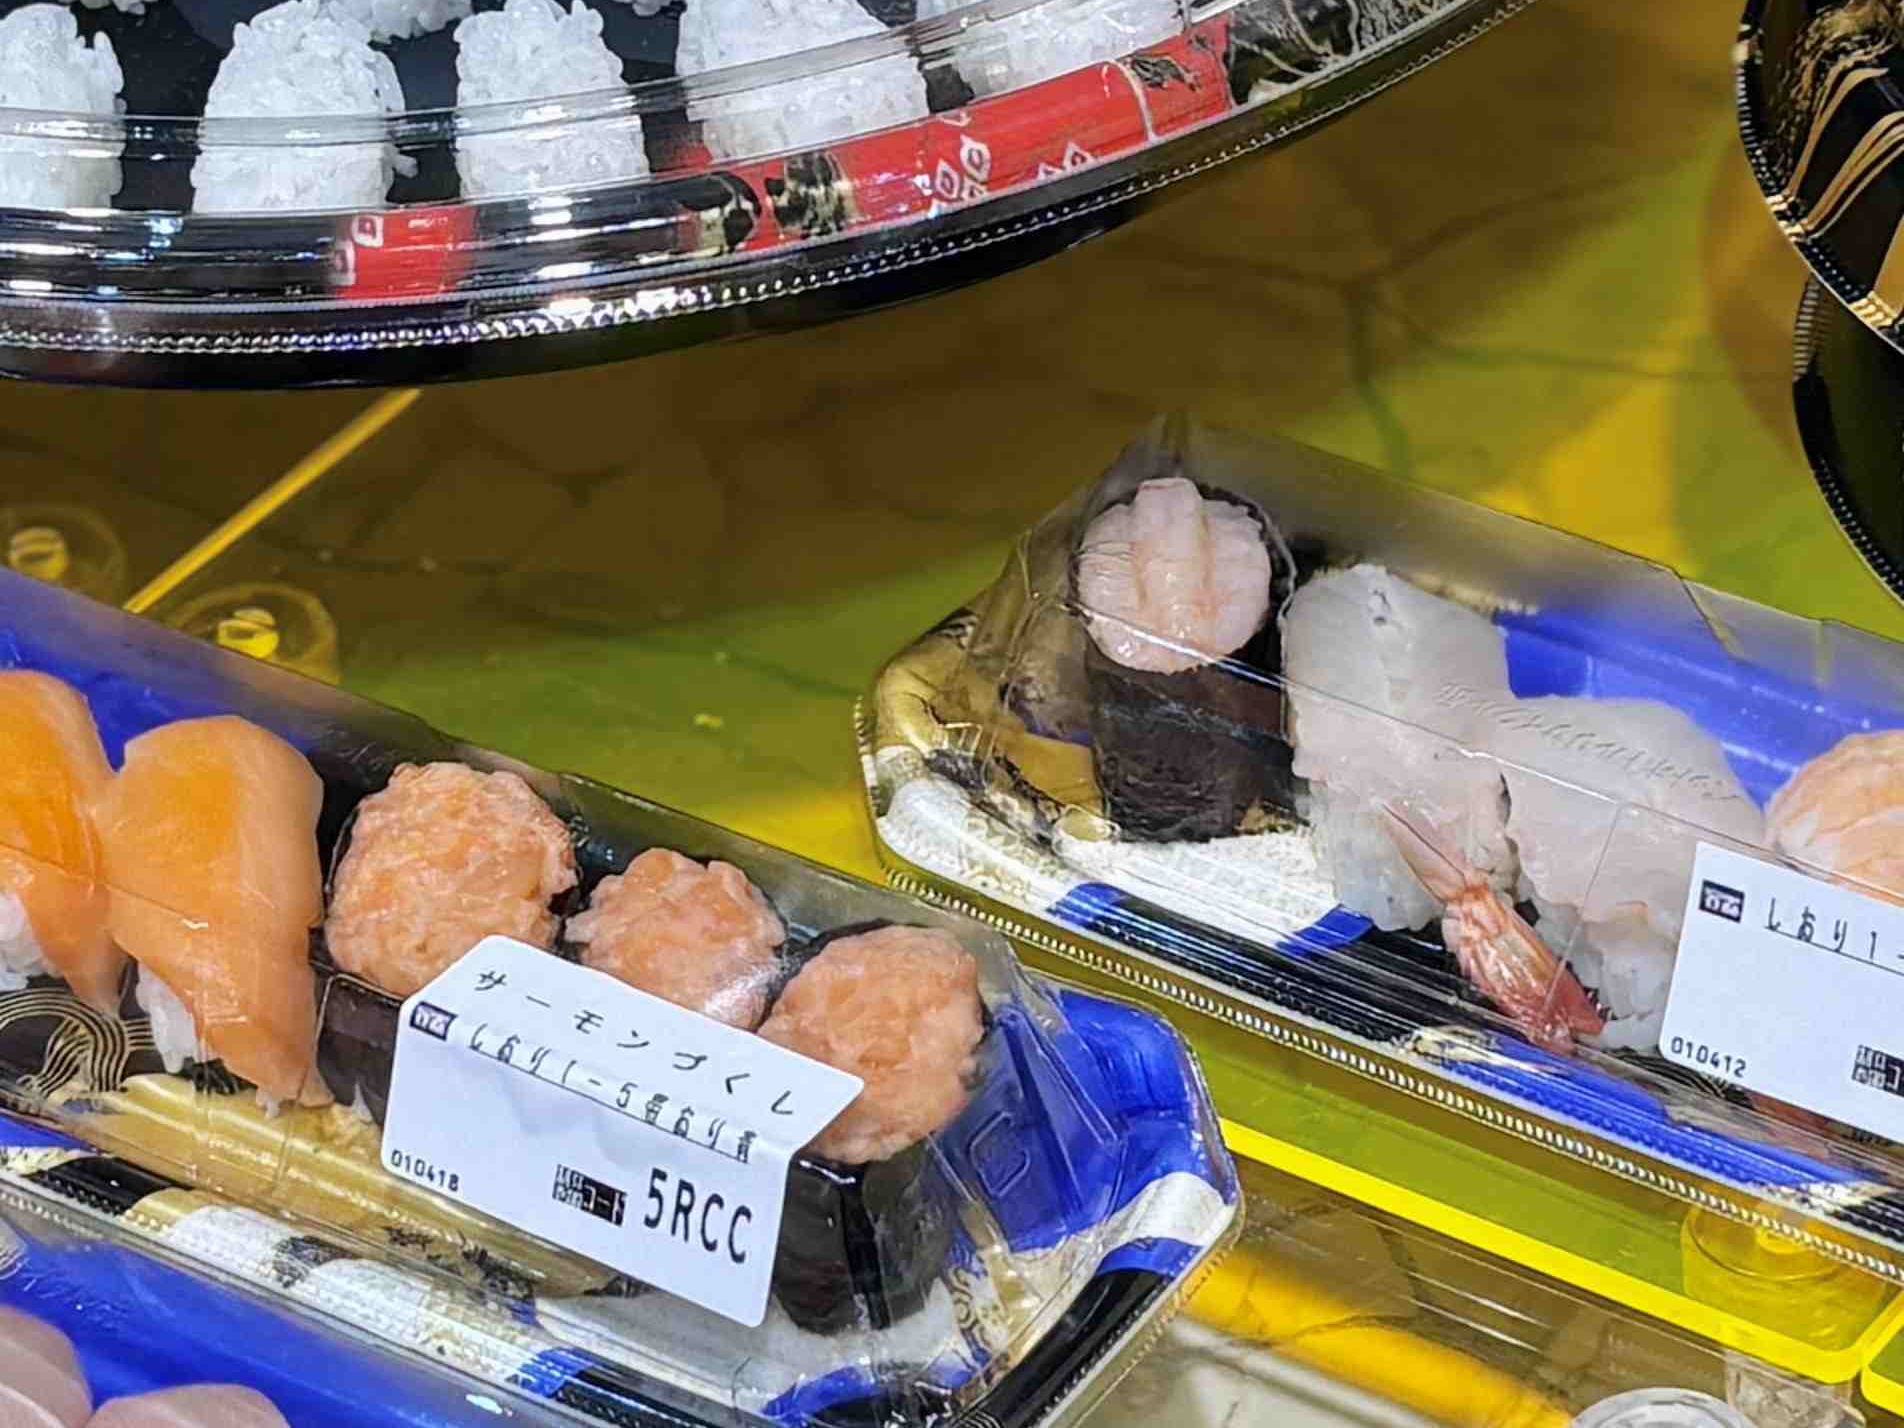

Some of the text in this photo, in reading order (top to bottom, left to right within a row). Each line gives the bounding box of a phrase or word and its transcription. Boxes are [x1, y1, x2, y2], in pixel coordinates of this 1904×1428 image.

[1671, 1036, 1747, 1079] 010412
[391, 1150, 460, 1192] 010418
[643, 1167, 753, 1265] 5RCC
